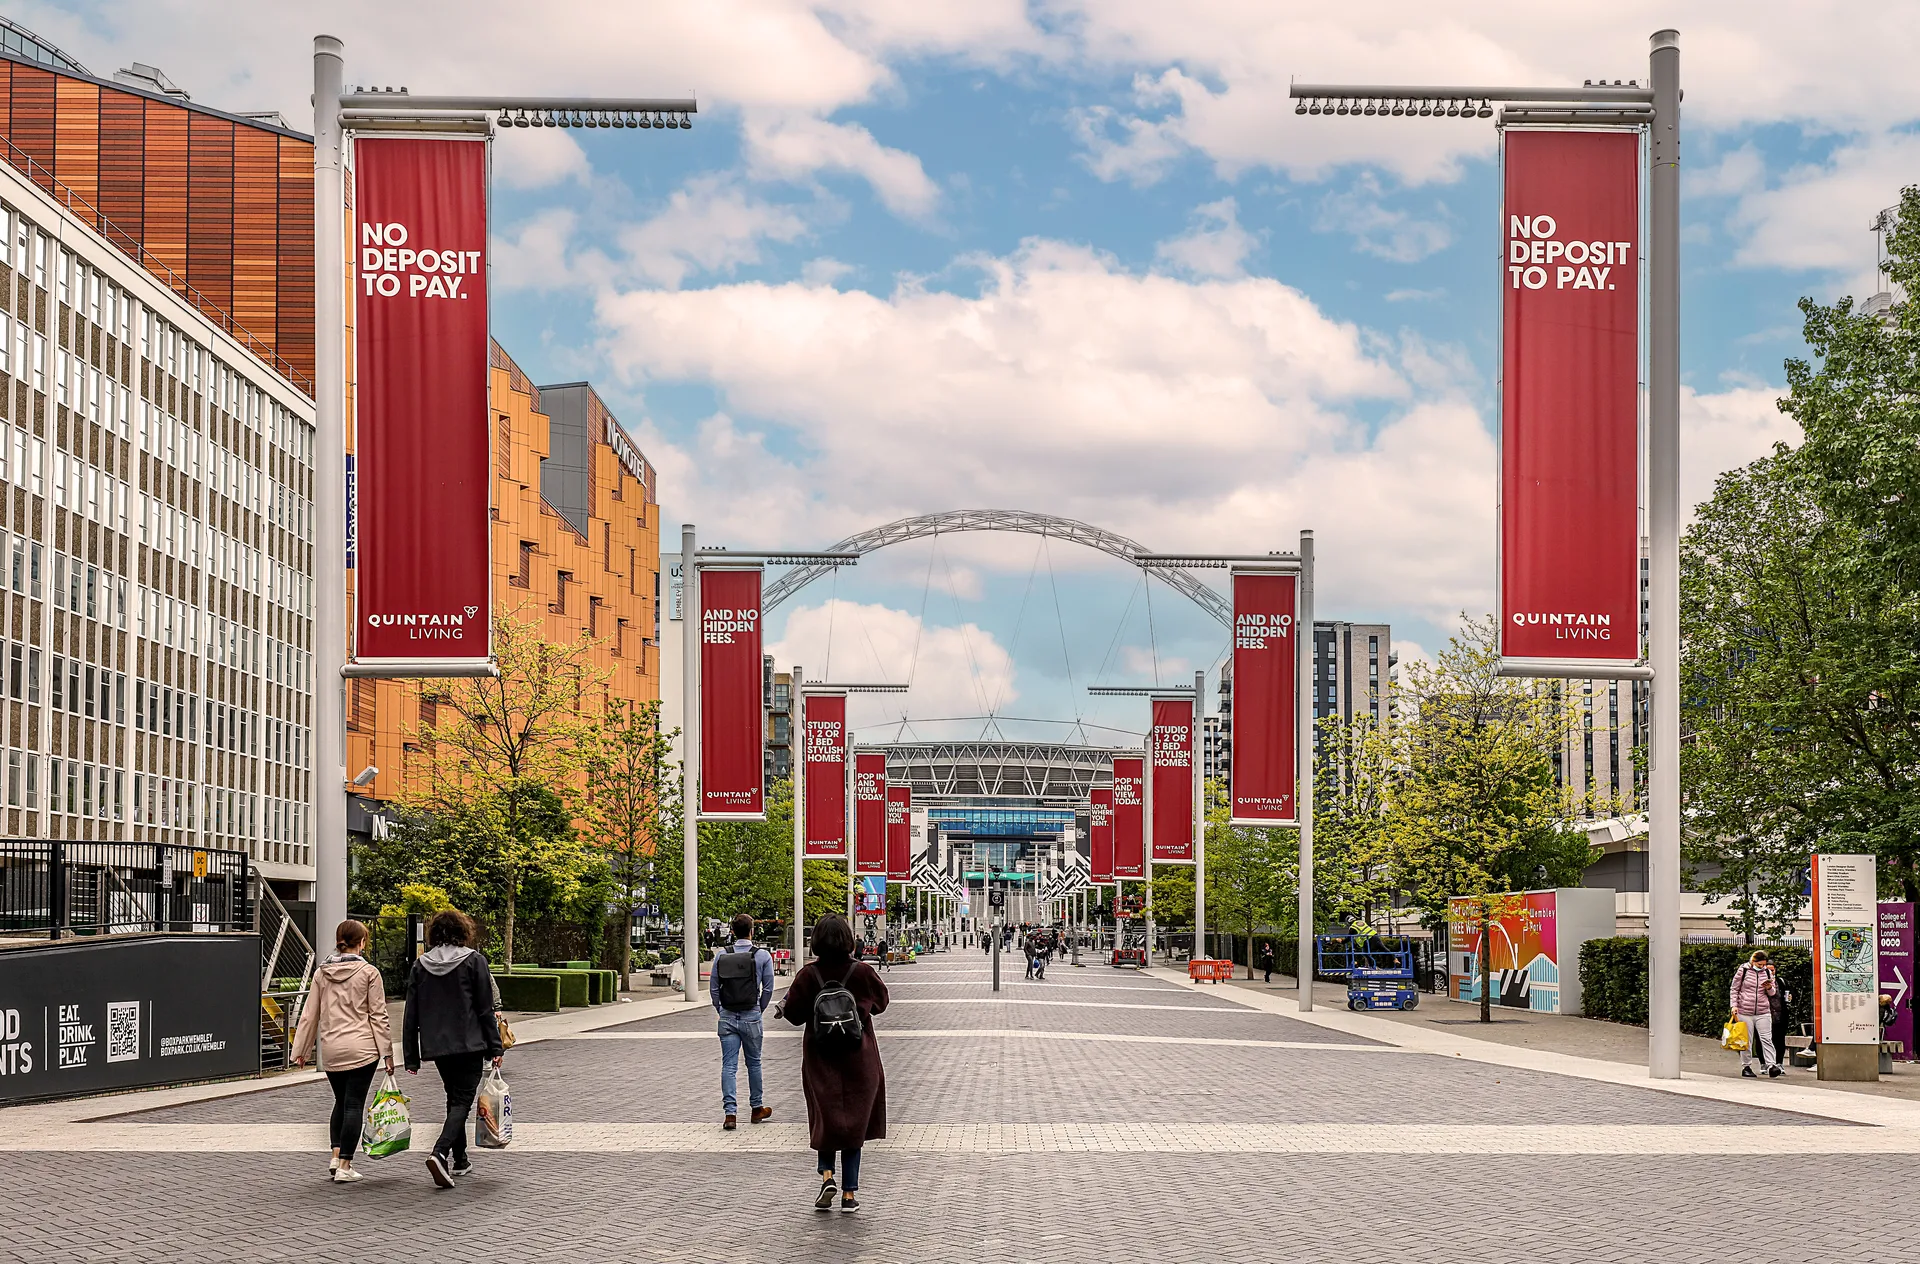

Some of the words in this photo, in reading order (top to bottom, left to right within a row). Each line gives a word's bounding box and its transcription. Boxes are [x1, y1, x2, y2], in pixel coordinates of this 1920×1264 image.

[1510, 215, 1557, 239] NO
[362, 222, 408, 247] NO
[1510, 240, 1631, 265] DEPOSIT
[362, 247, 481, 274] DEPOSIT
[1508, 266, 1548, 290] TO
[1557, 266, 1615, 290] PAY.
[361, 273, 401, 297] TO
[409, 274, 468, 299] PAY.
[368, 614, 463, 627] QUINTAIN
[703, 609, 733, 620] AND
[737, 609, 759, 620] NO
[1236, 614, 1267, 625] AND
[1270, 614, 1292, 626] NO
[1512, 613, 1610, 626] QUINTAIN
[703, 621, 754, 632] HIDDEN
[1236, 626, 1287, 638] HIDDEN
[410, 628, 463, 639] LIVING
[703, 632, 735, 644] FEES.
[1556, 628, 1610, 640] LIVING
[1236, 637, 1268, 649] FEES.
[807, 721, 841, 729] STUDIO
[1154, 726, 1189, 734] STUDIO
[808, 730, 815, 739] 1,
[825, 730, 839, 738] OR
[1154, 734, 1161, 743] 1,
[1163, 734, 1170, 742] 2
[1172, 734, 1187, 742] OR
[807, 746, 844, 754] STYLISH
[1154, 742, 1160, 750] 3
[1162, 742, 1180, 750] BED
[807, 754, 844, 762] HOMES.
[1154, 751, 1191, 759] STYLISH
[1154, 758, 1191, 767] HOMES.
[1530, 908, 1555, 919] Wembley
[1880, 913, 1899, 921] College
[1900, 912, 1906, 920] of
[1451, 922, 1464, 934] FREE
[1530, 922, 1542, 932] Park
[1880, 921, 1894, 929] North
[1895, 921, 1909, 929] West
[59, 1004, 80, 1022] EAT.
[59, 1024, 96, 1044] DRINK.
[161, 1033, 213, 1047] @BOXPARKWEMBLEY
[161, 1041, 226, 1057] BOXPARK.CO.UK/WEMBLEY
[59, 1046, 87, 1065] PLAY.
[373, 1109, 398, 1120] BRING
